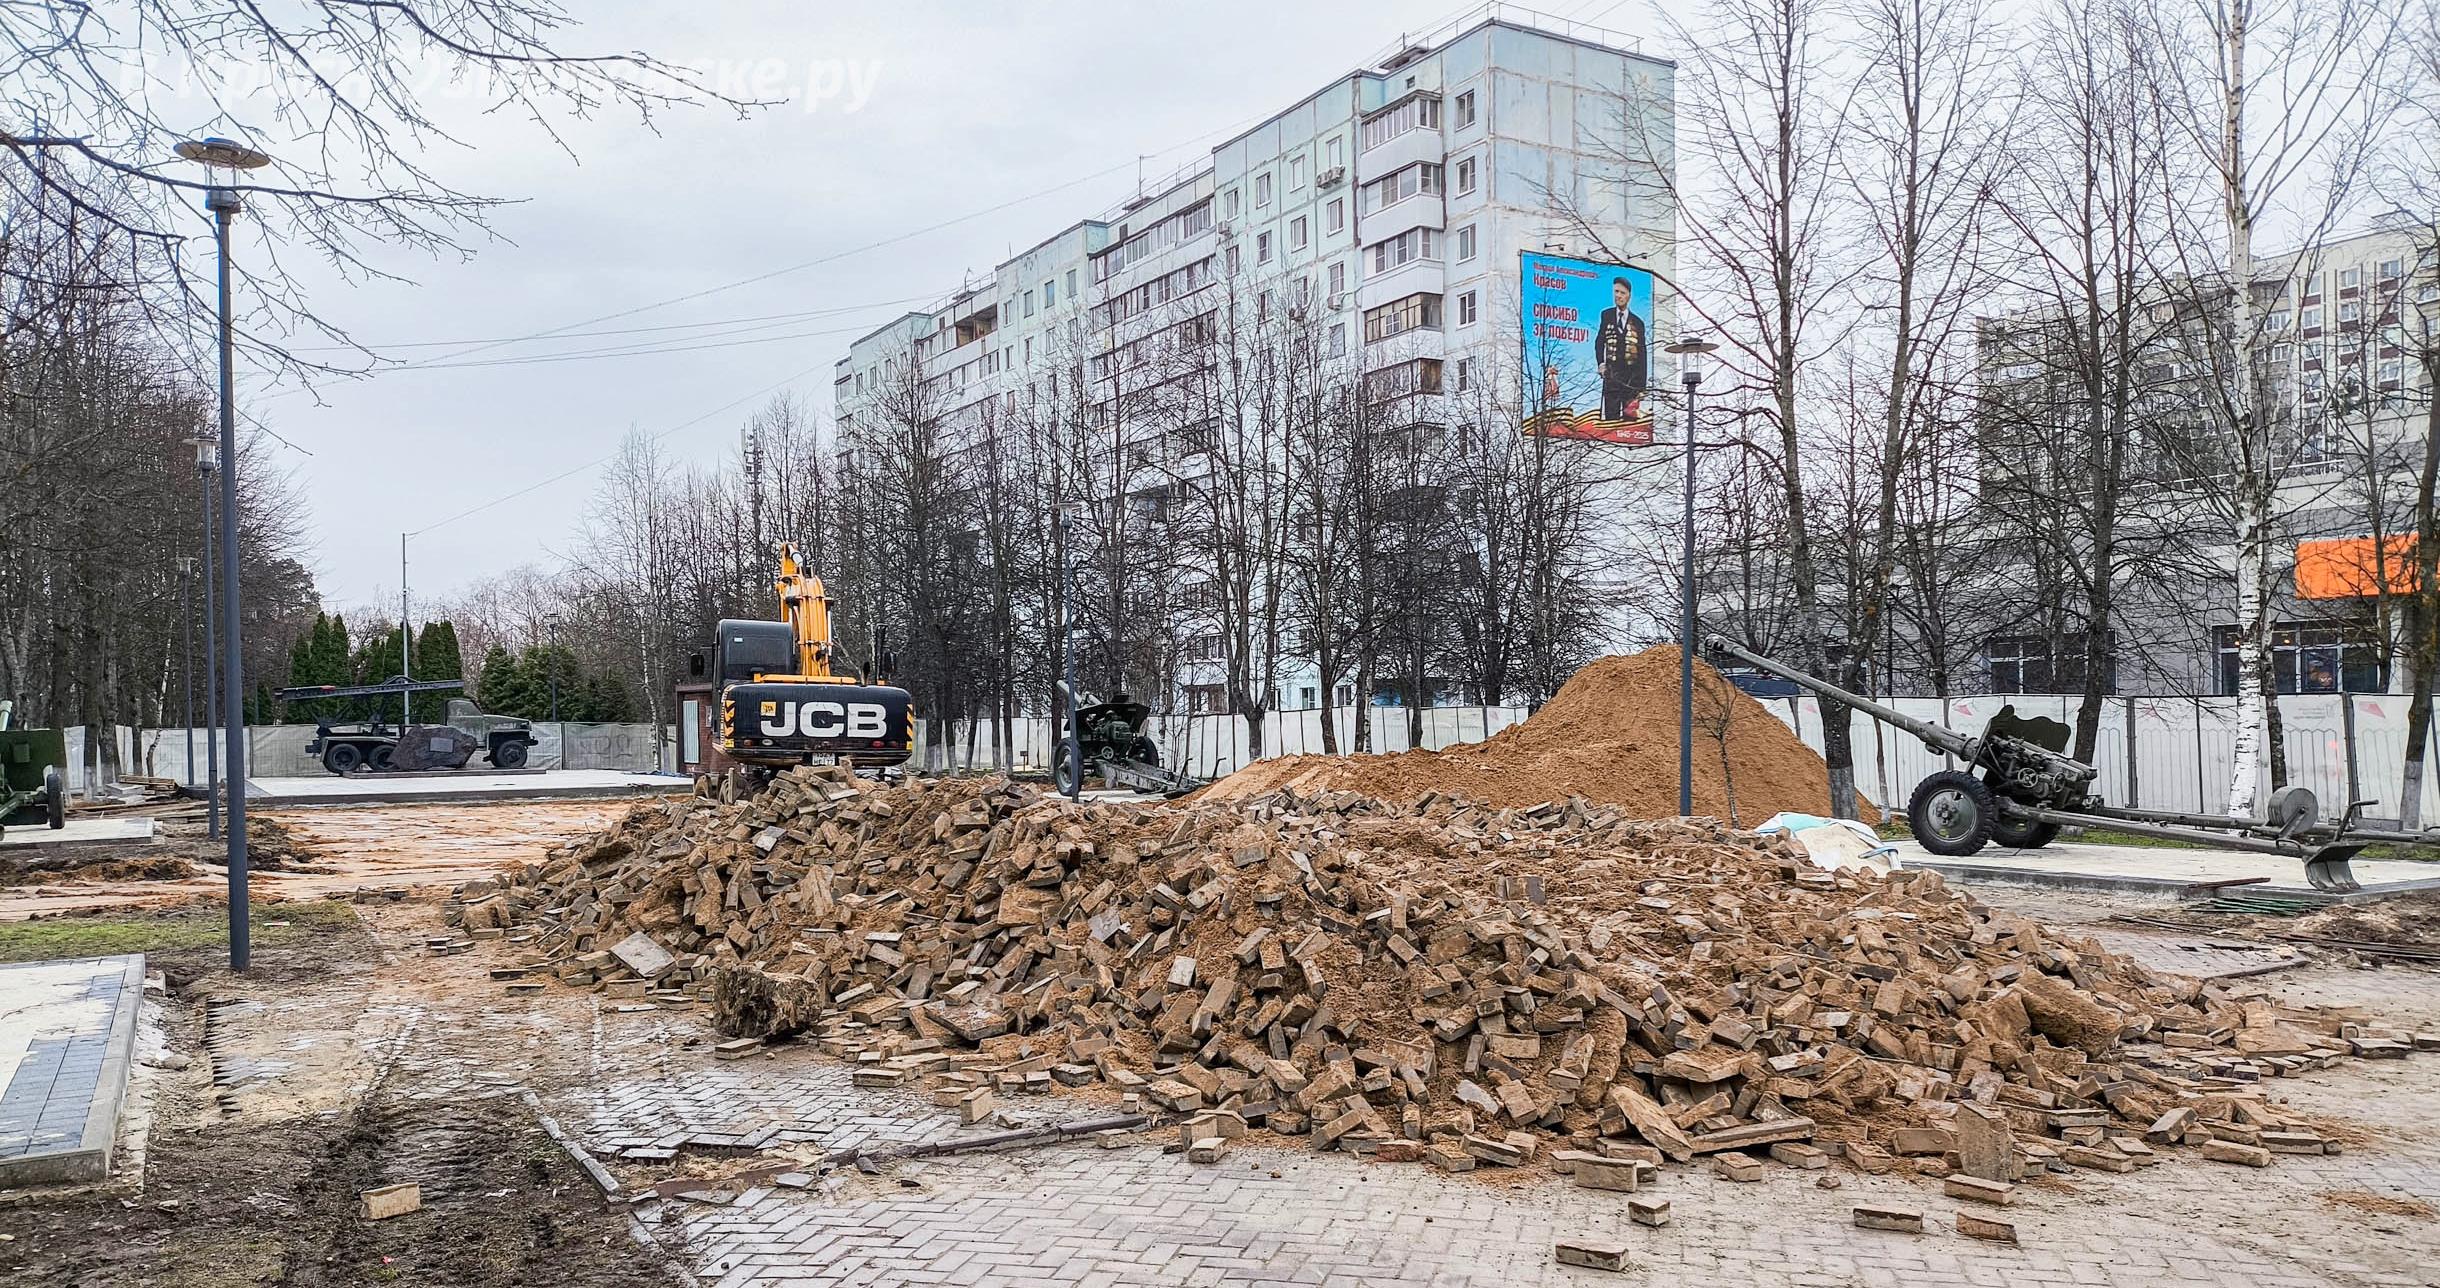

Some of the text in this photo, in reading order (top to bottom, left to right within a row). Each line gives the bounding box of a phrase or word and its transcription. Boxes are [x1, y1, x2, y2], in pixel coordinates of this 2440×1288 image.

[1533, 272, 1567, 290] Красов
[1533, 303, 1578, 322] СПАСИБО
[1548, 324, 1589, 343] ПОБЕДУ!
[760, 701, 887, 738] JCB
